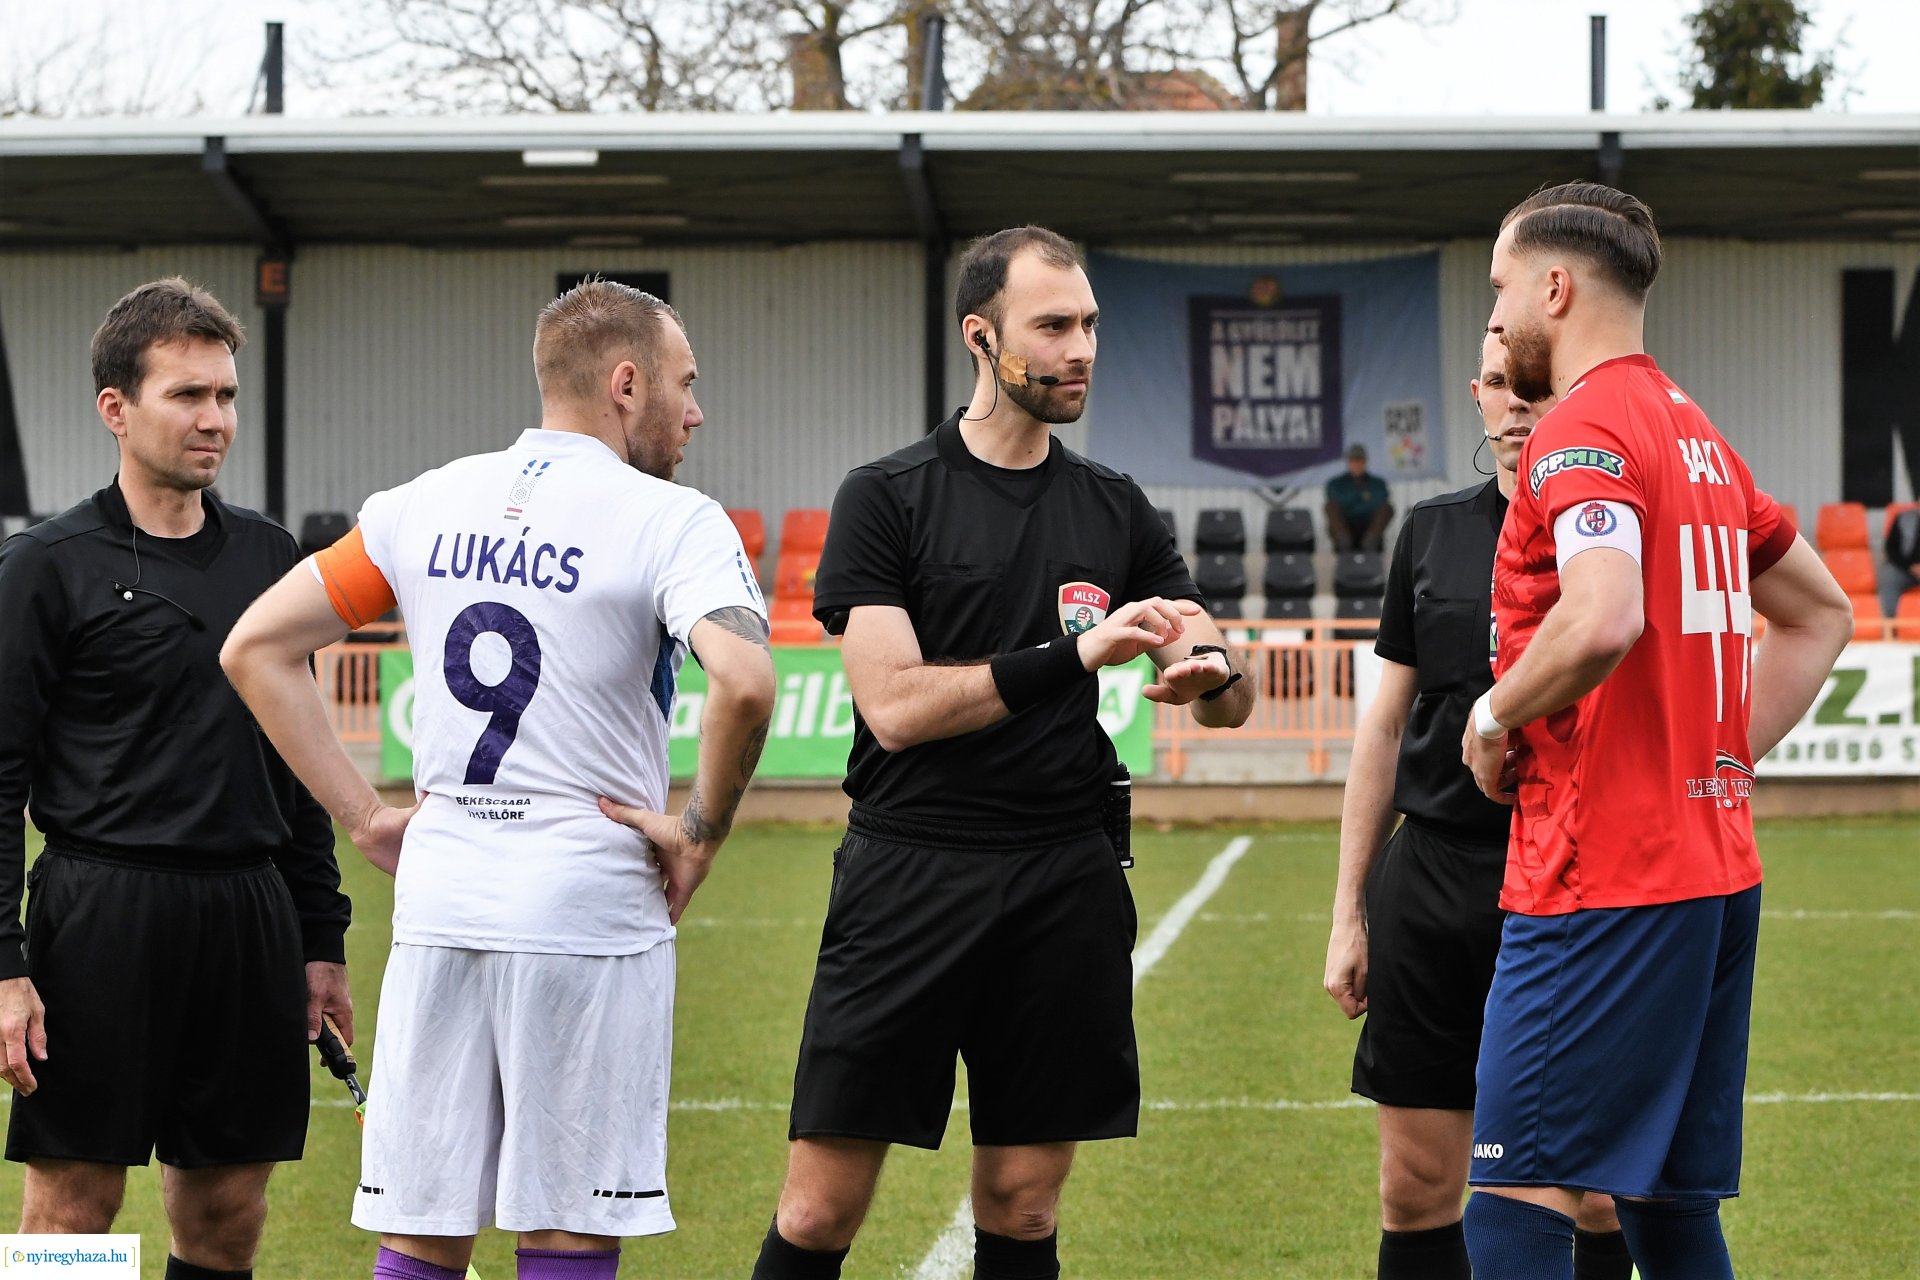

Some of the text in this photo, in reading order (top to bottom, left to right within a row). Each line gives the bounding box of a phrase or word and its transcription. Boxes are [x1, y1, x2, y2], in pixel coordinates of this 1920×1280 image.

[1211, 344, 1321, 398] NEM
[1212, 400, 1321, 440] PÁLYA!
[427, 526, 584, 593] LUKÁCS
[1073, 591, 1100, 604] MLSZ
[1679, 524, 1752, 722] 44
[443, 601, 541, 785] 9
[456, 795, 531, 806] BÉKÉSCSABA
[488, 808, 525, 820] ÉLŐRE
[1473, 1143, 1504, 1159] JAKO
